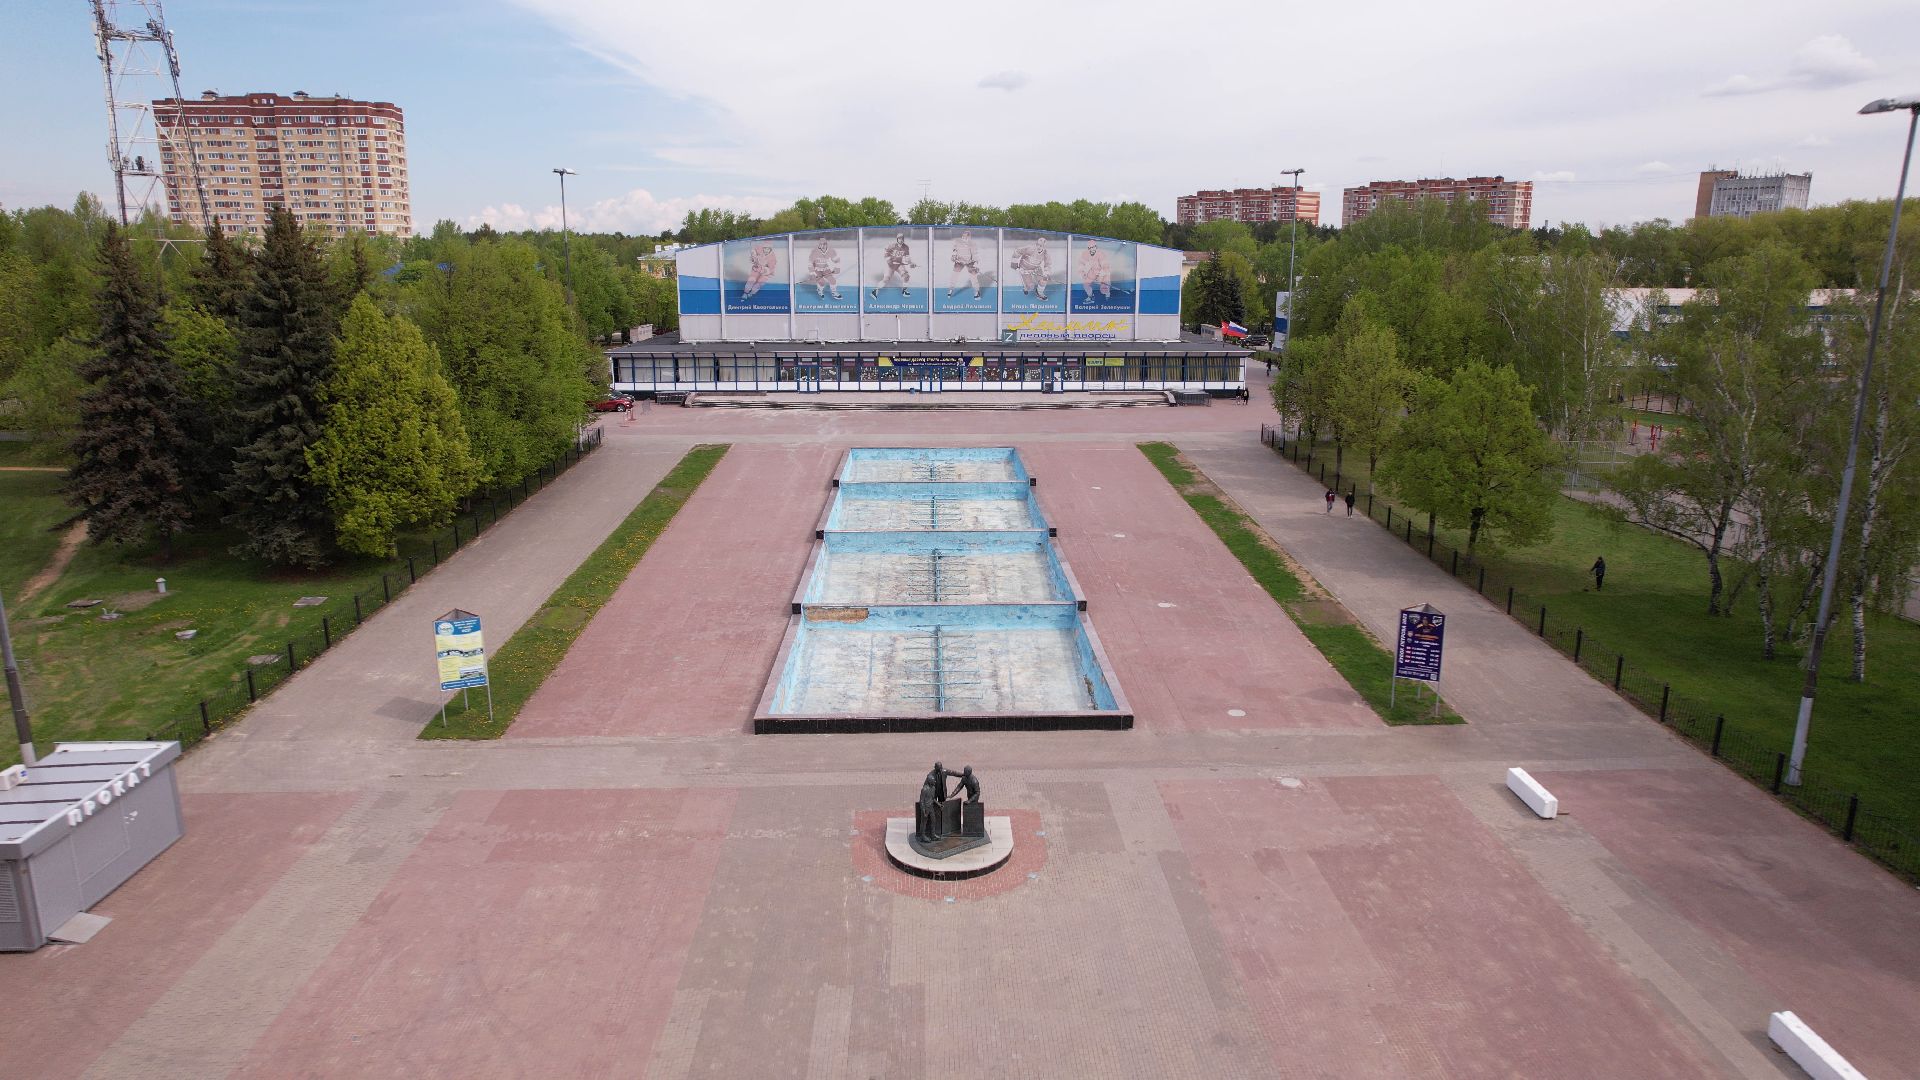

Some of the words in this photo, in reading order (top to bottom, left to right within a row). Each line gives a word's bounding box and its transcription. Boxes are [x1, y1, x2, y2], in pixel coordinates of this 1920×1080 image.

[1005, 332, 1013, 342] Z
[1019, 331, 1070, 340] ледовый
[1074, 332, 1116, 340] дворец
[67, 763, 151, 826] ПРОКАТ
